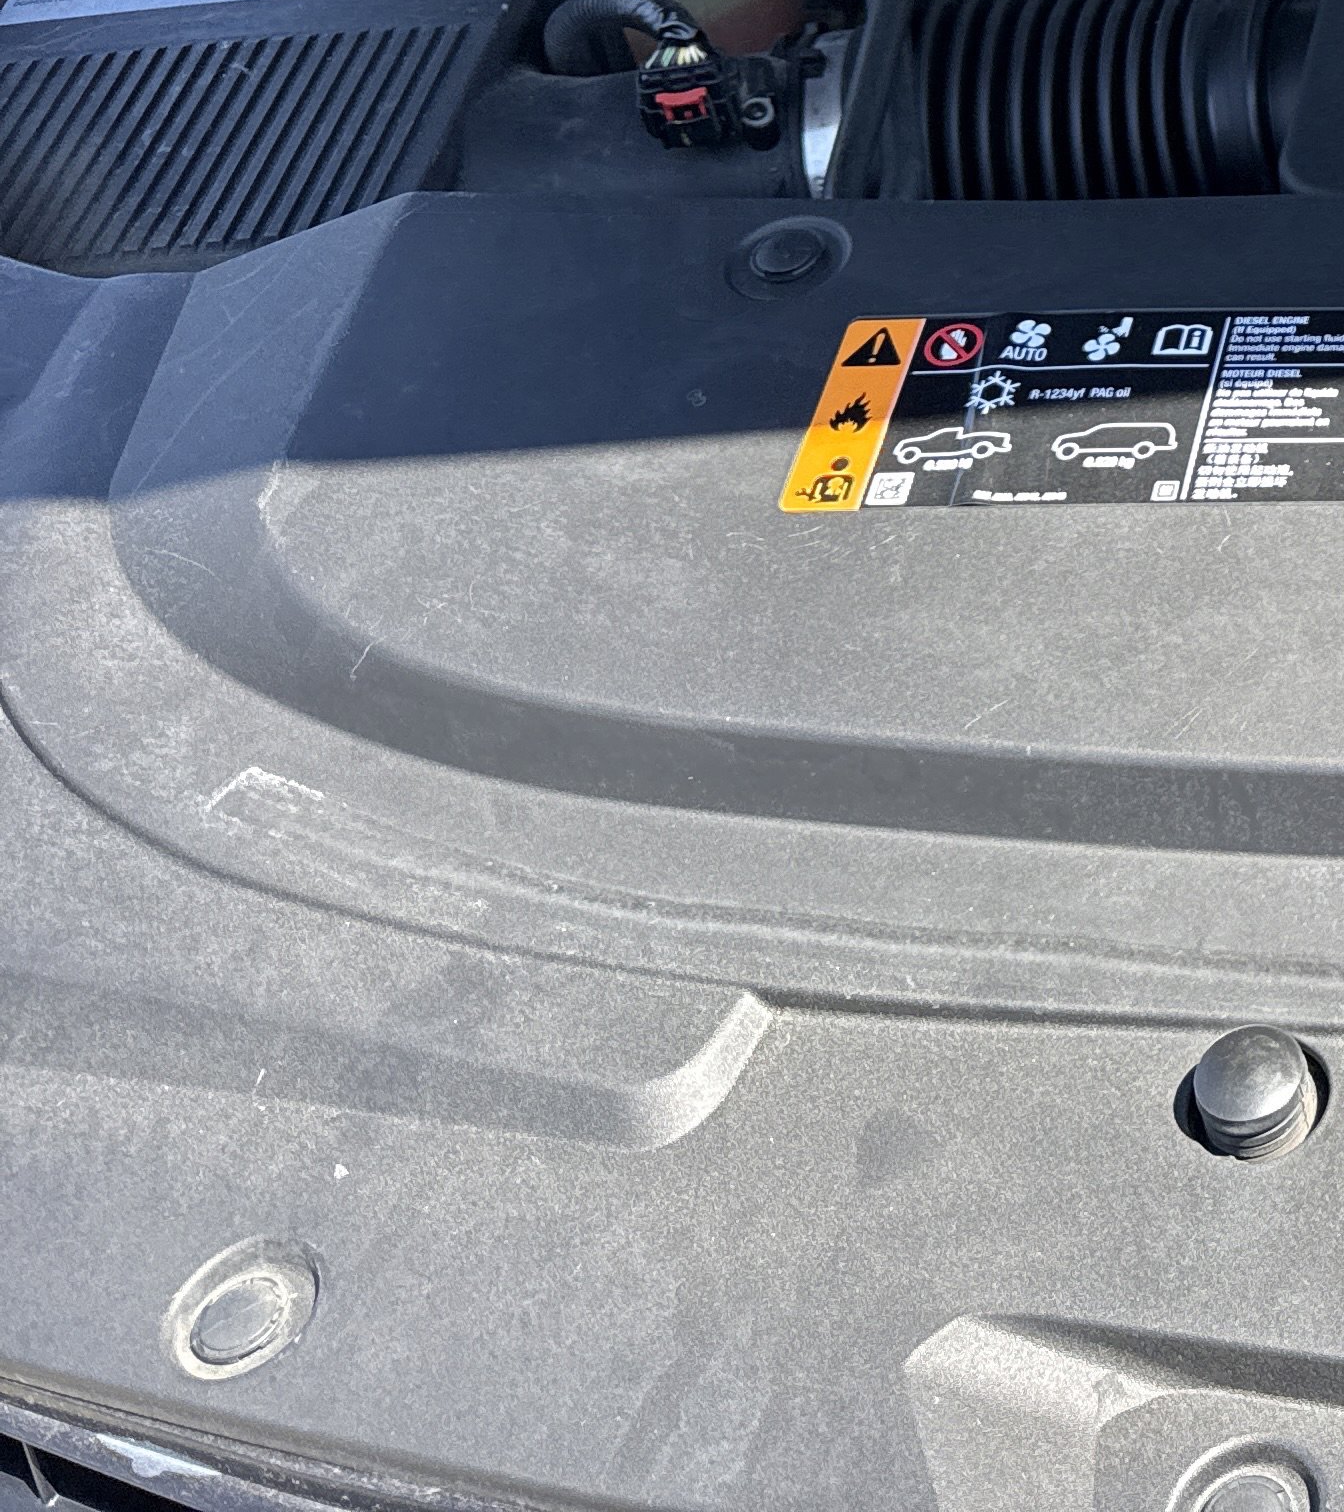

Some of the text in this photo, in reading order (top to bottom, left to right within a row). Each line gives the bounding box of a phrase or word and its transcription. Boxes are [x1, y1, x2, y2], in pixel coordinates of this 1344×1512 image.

[1234, 316, 1310, 325] DIESEL ENGINE
[1229, 335, 1244, 343] Do
[1245, 335, 1263, 343] not
[1264, 335, 1282, 343] use
[1283, 334, 1322, 344] starting
[998, 345, 1048, 361] AUTO
[1280, 344, 1315, 354] engine
[1221, 369, 1302, 378] MOTEUR DIESEL
[1027, 386, 1132, 401] R-1234yf PAG oil
